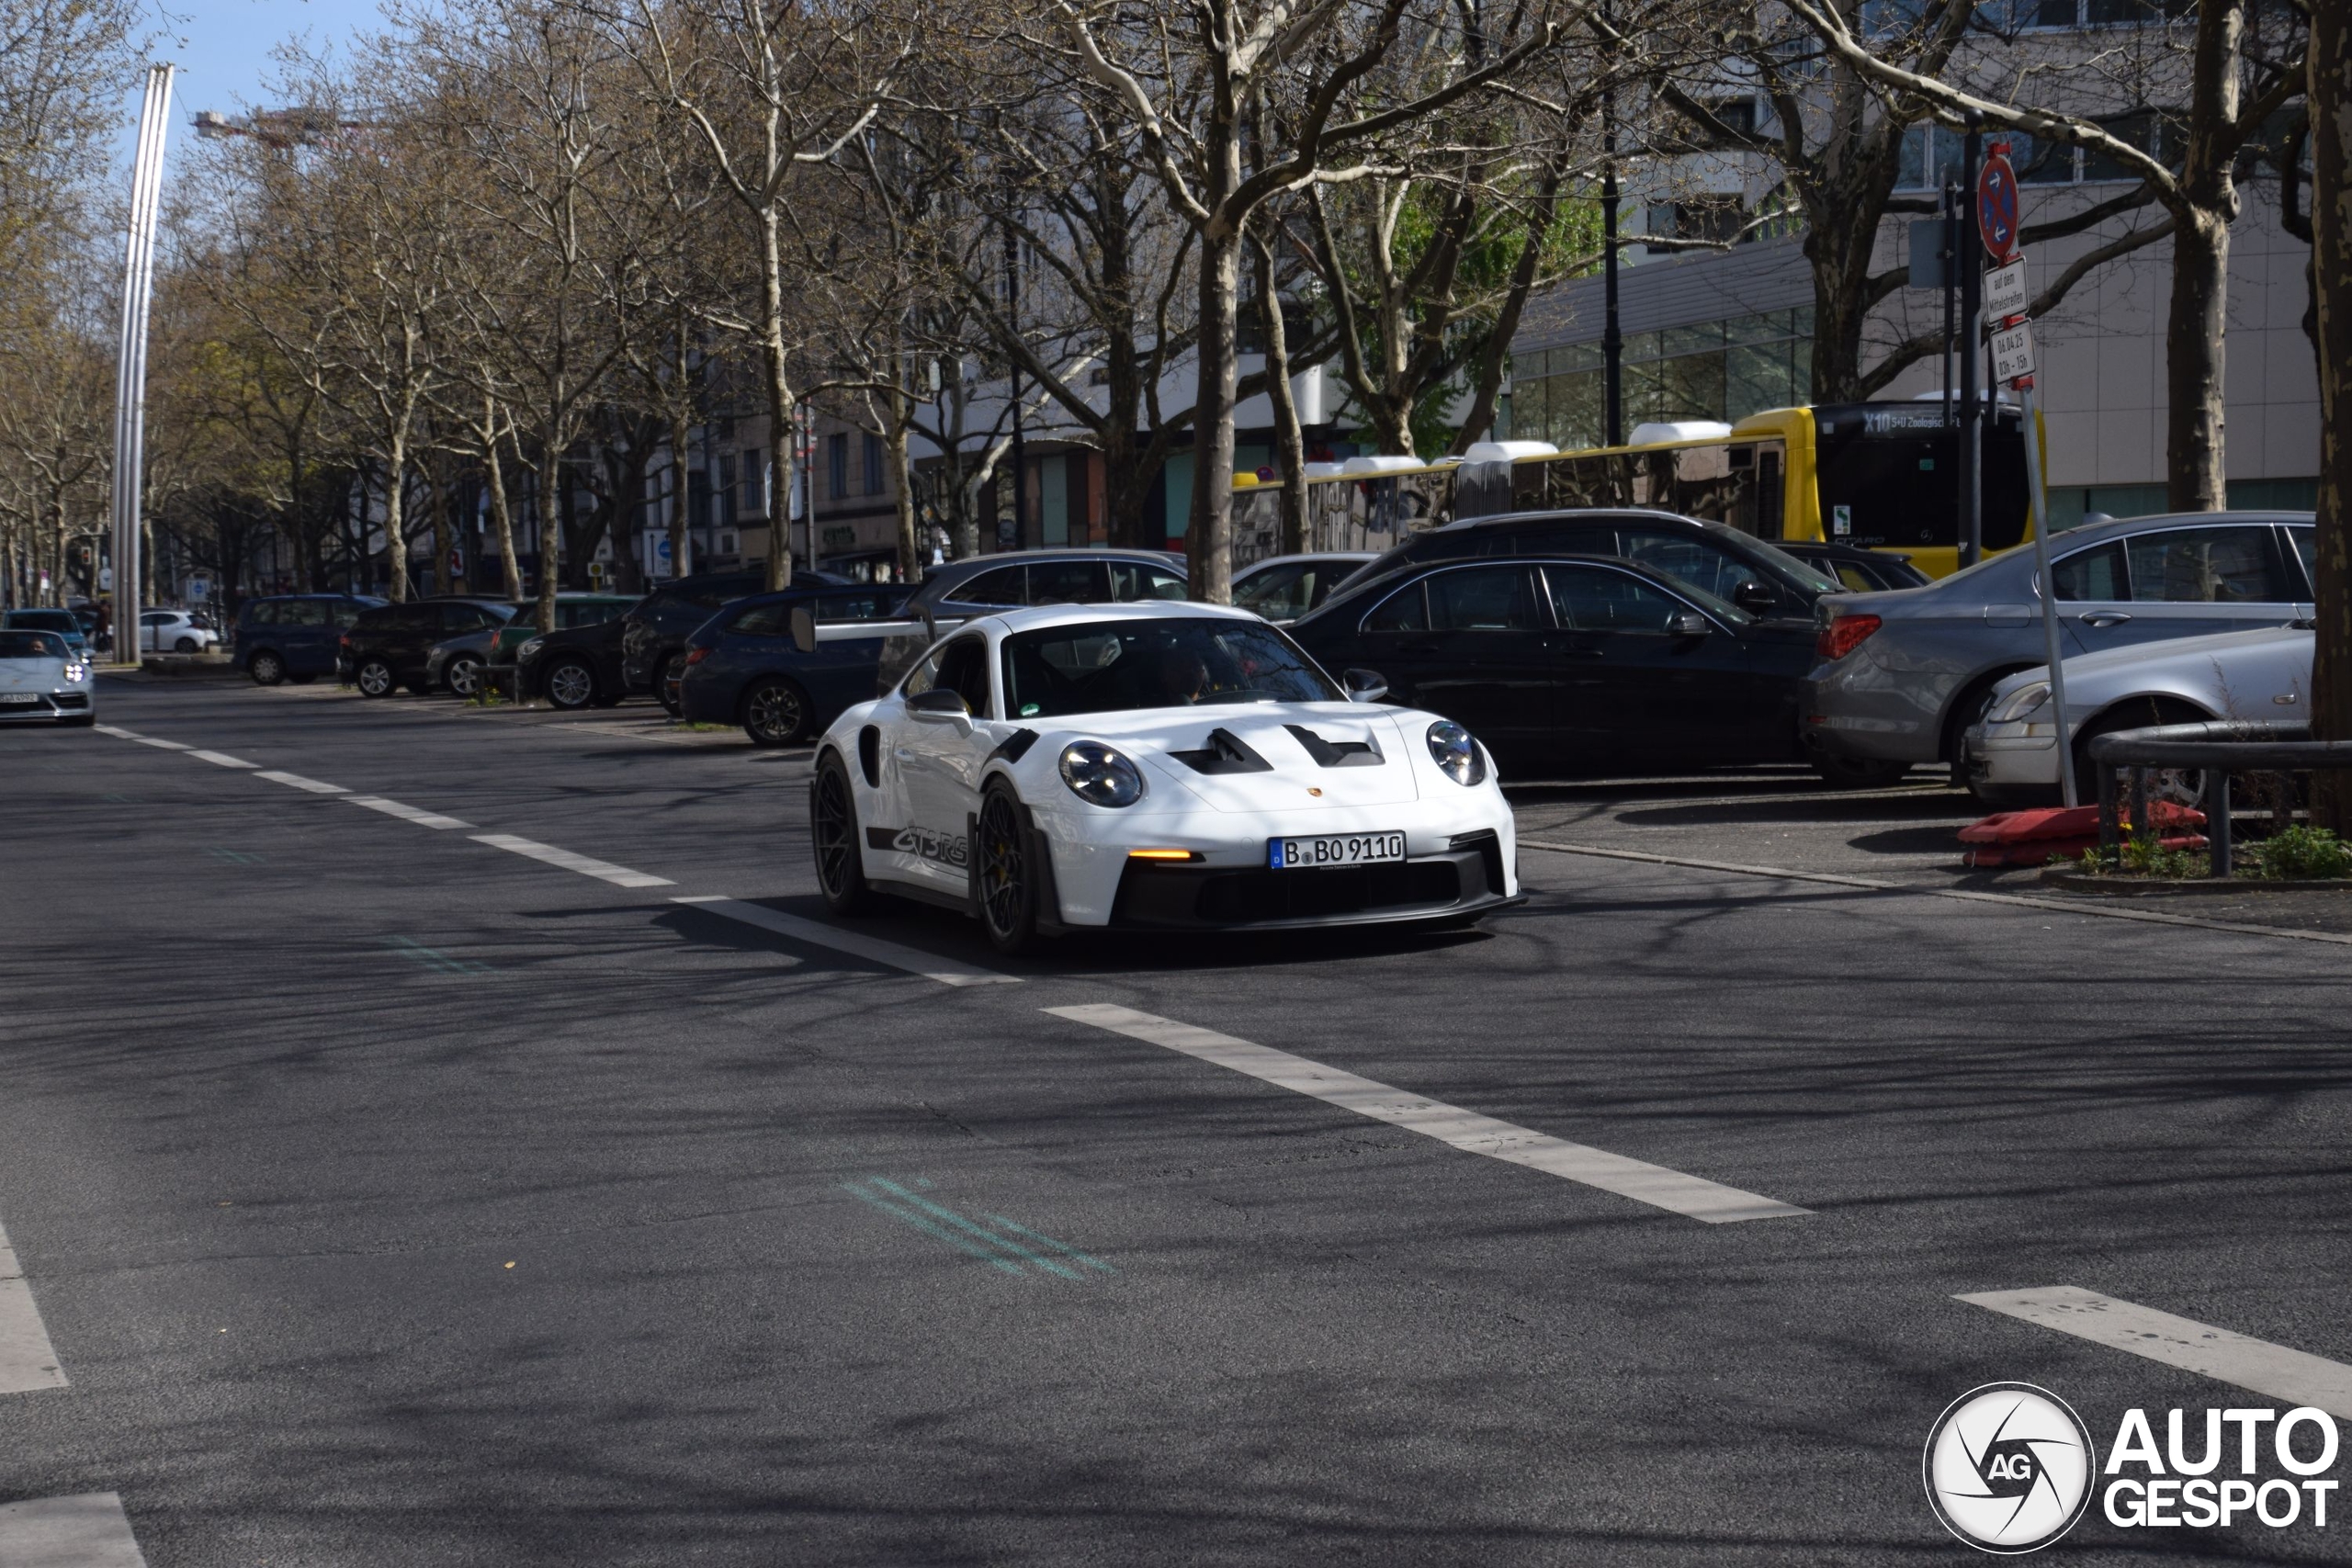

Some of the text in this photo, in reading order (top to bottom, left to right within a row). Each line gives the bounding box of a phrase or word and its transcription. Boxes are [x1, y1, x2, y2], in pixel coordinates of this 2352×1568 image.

[1995, 273, 2015, 290] auf dem
[1989, 291, 2023, 314] Mittelstreifen
[1998, 333, 2023, 354] 06.04.25
[1999, 360, 2010, 376] 03h
[2017, 354, 2028, 370] 15h
[1865, 413, 1890, 432] X10
[1892, 418, 1906, 428] S+U
[1907, 417, 1944, 428] Zoologisc
[1286, 841, 1300, 864] B
[1315, 840, 1344, 863] BO
[1349, 836, 1401, 861] 9110
